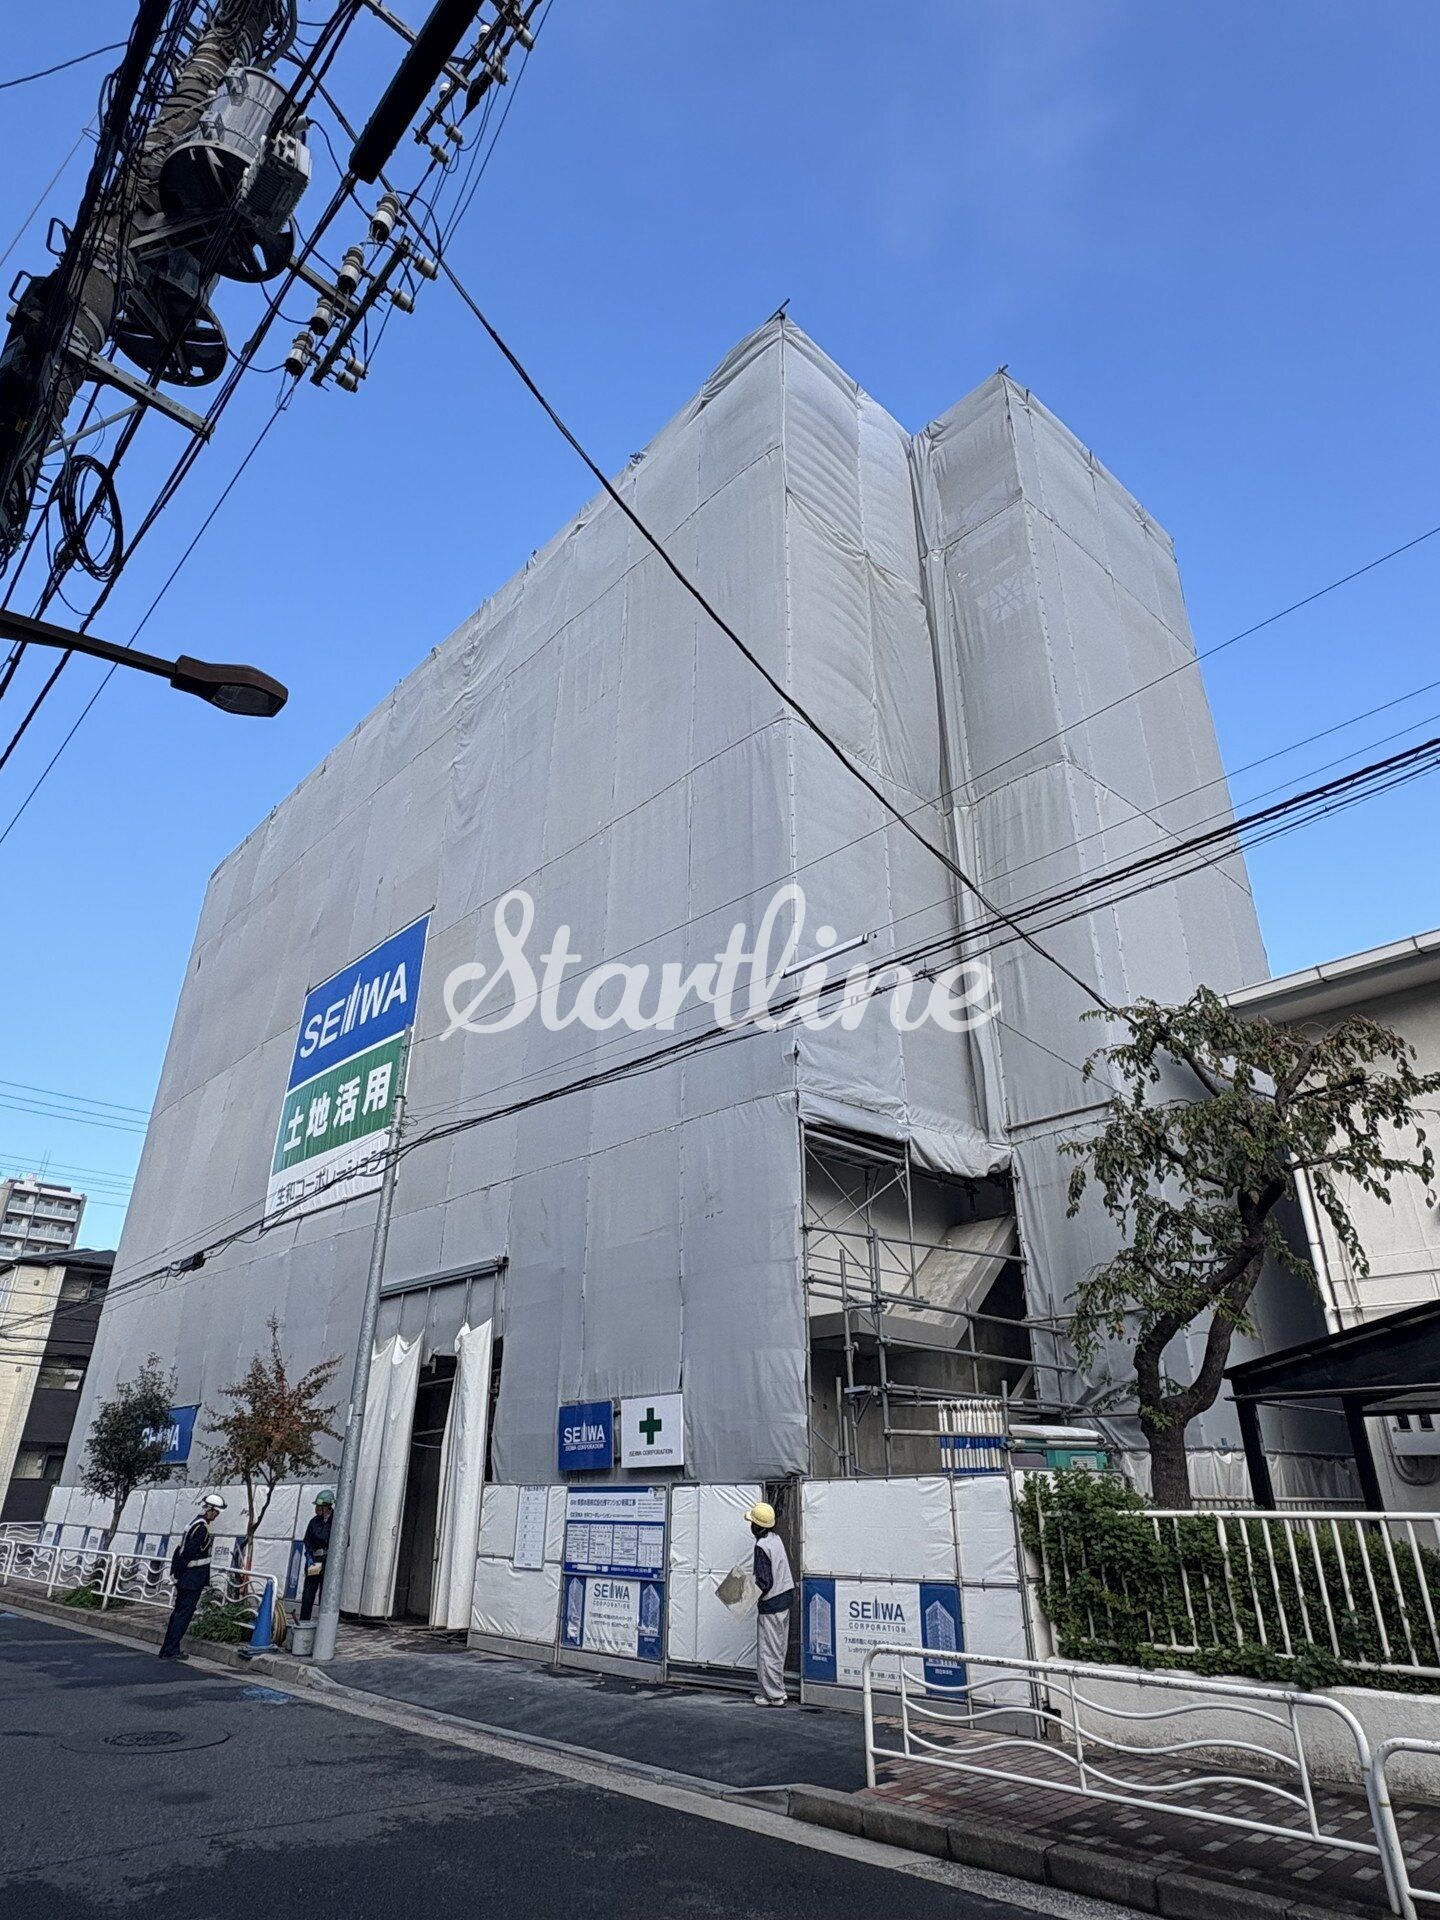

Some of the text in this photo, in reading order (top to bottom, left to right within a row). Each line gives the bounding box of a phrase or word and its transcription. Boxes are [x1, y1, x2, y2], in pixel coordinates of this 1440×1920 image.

[300, 961, 408, 1059] SEIWA
[283, 1062, 393, 1153] 土地活用
[563, 1420, 605, 1443] SEIWA
[593, 1580, 630, 1600] SEIWA
[592, 1600, 630, 1609] CORPORATION
[849, 1595, 905, 1622] SEIWA
[848, 1622, 906, 1633] CORPORATION
